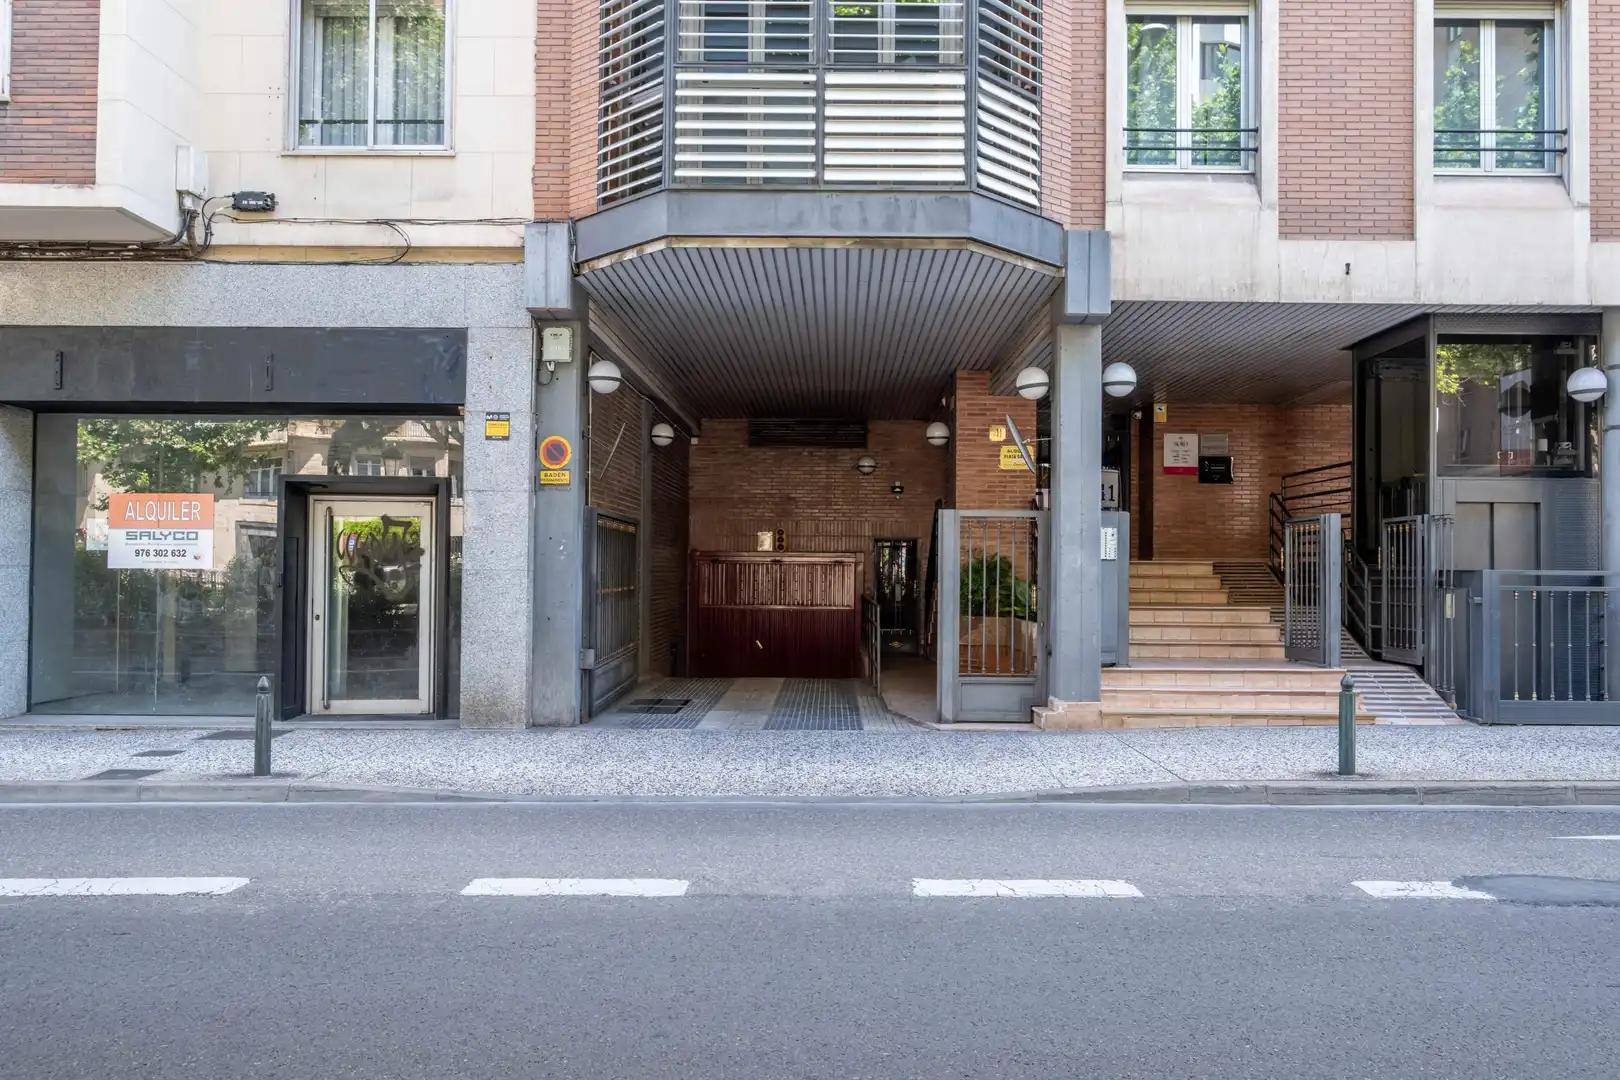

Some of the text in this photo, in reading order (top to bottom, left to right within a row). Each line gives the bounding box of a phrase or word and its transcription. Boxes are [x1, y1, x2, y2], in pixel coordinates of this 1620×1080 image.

[124, 500, 201, 523] ALQUILER
[125, 531, 199, 541] SALYCO
[134, 548, 187, 558] 976 302 632
